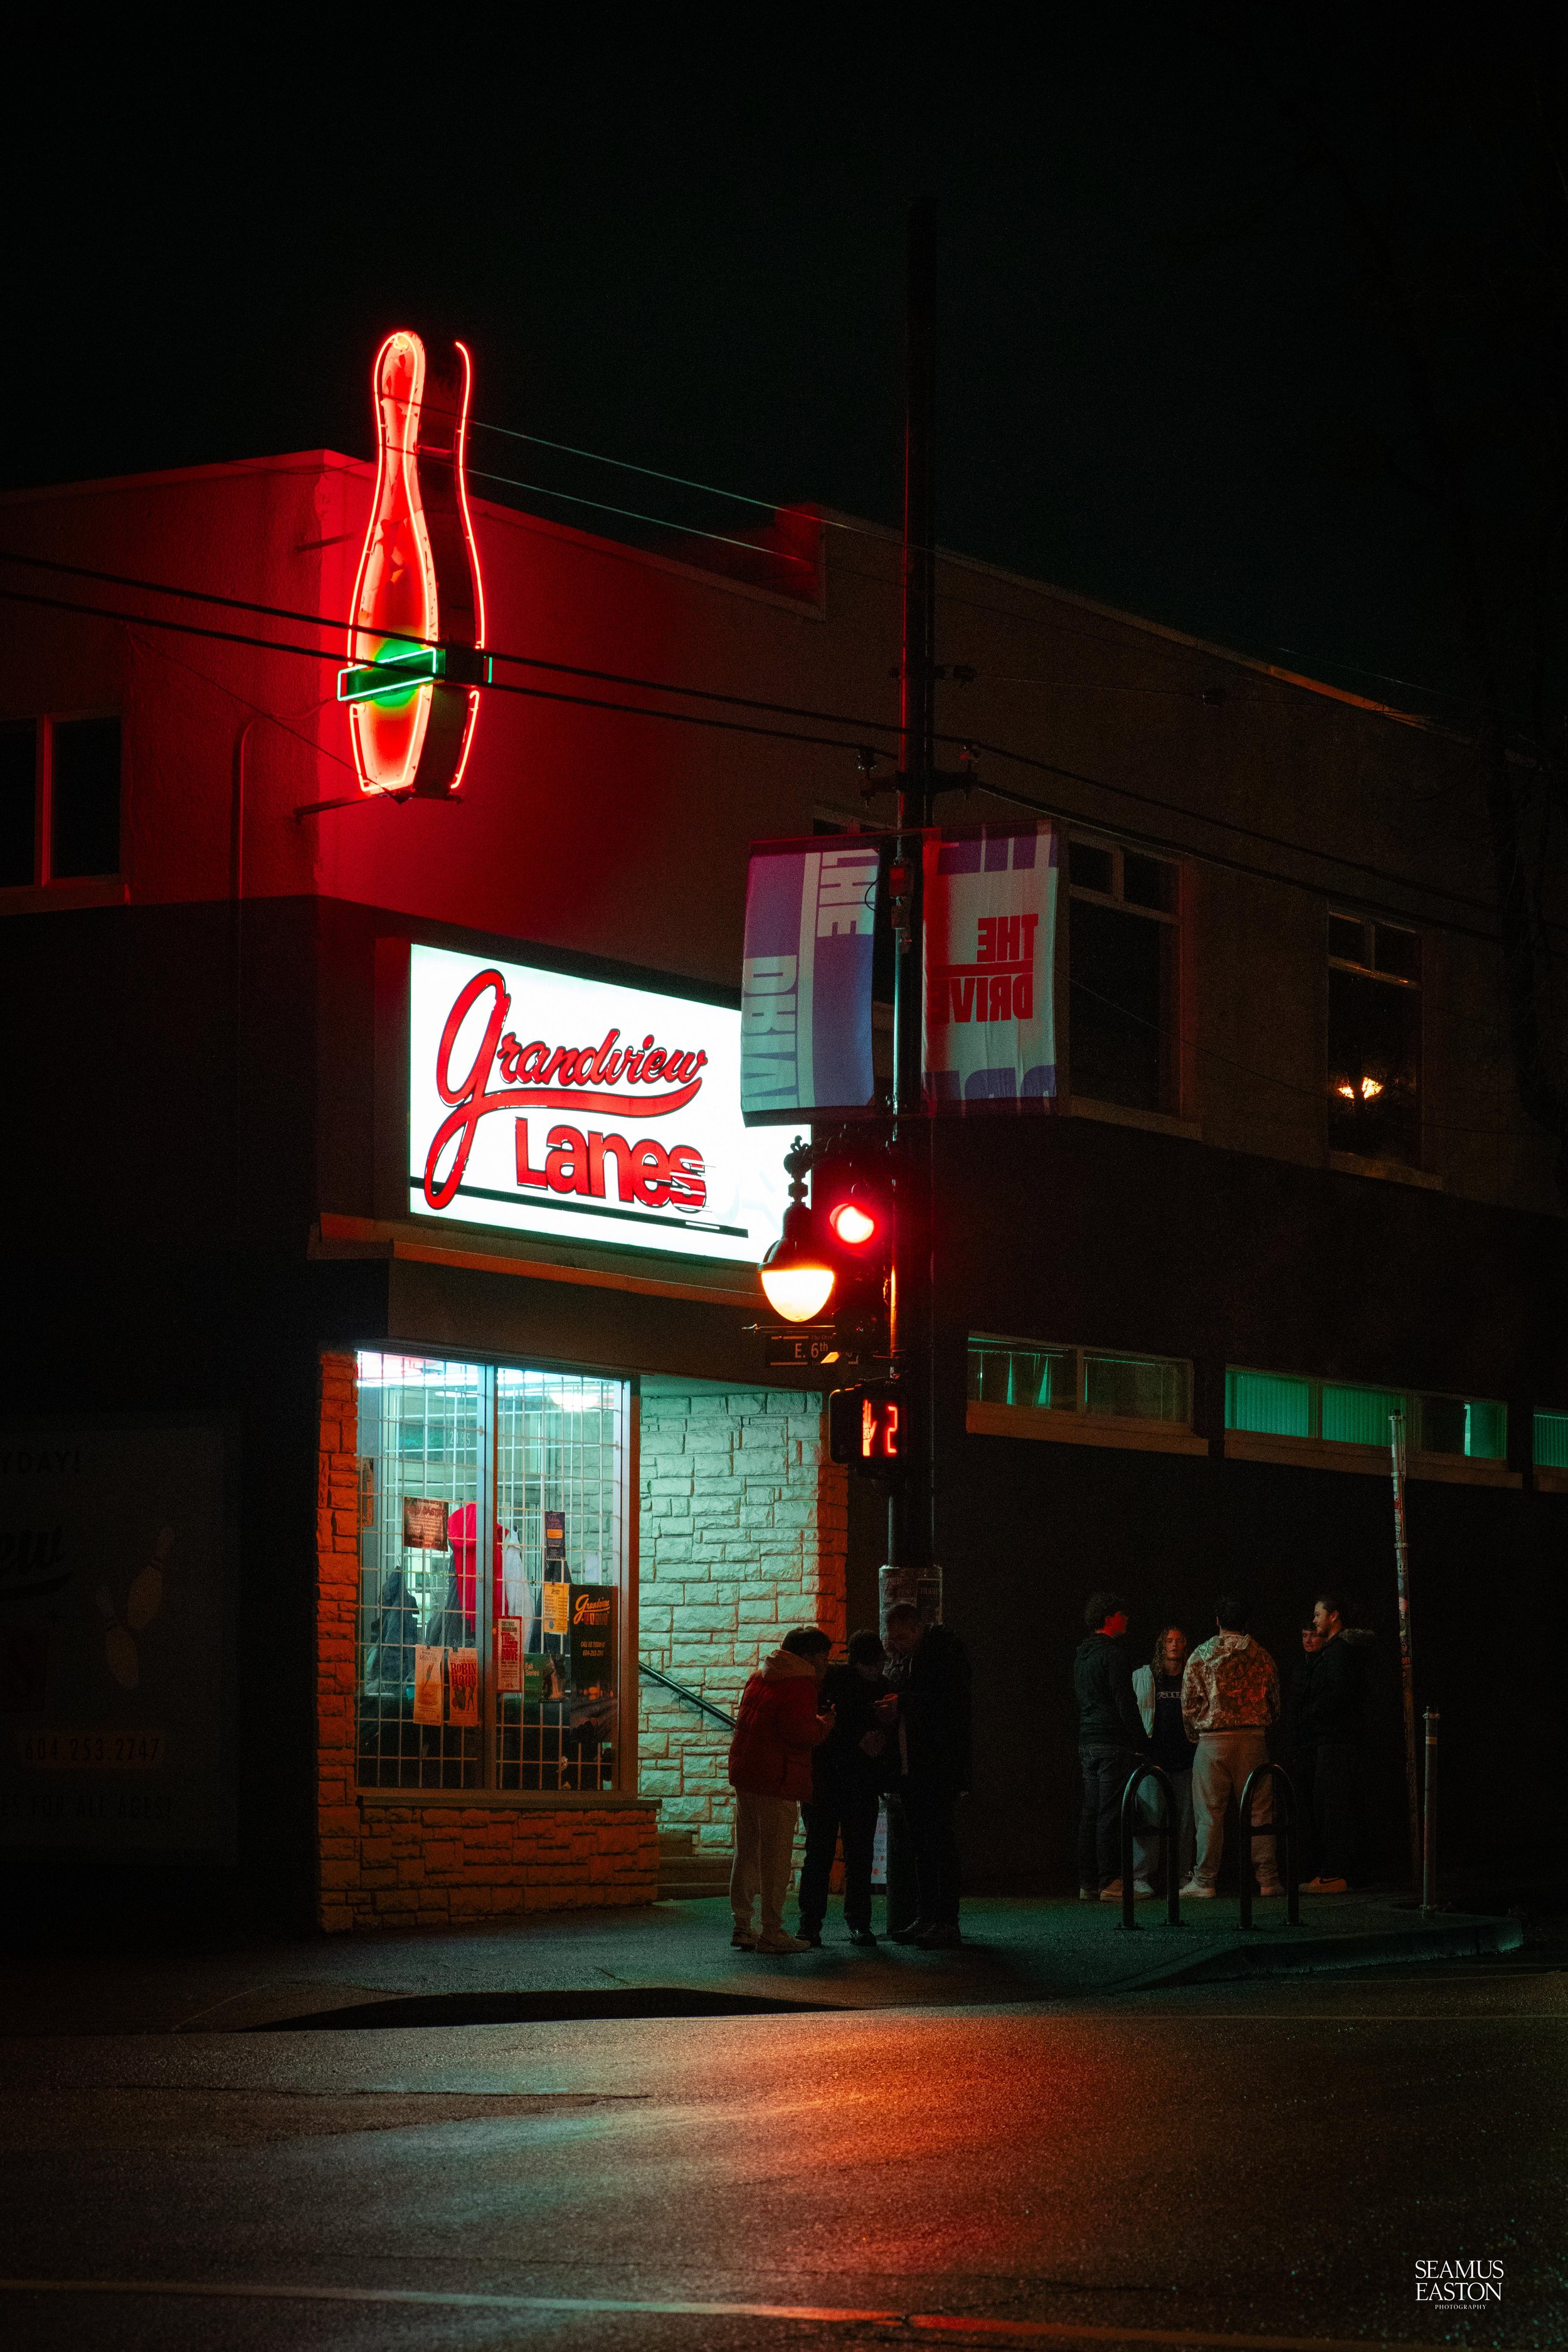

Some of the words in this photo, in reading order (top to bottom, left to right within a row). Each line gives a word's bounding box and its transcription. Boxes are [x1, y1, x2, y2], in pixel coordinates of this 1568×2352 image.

[515, 1116, 707, 1213] Lanes
[795, 1343, 806, 1359] E.
[810, 1342, 829, 1359] 6th
[450, 1663, 477, 1675] ROBIN
[451, 1675, 477, 1687] HOOD
